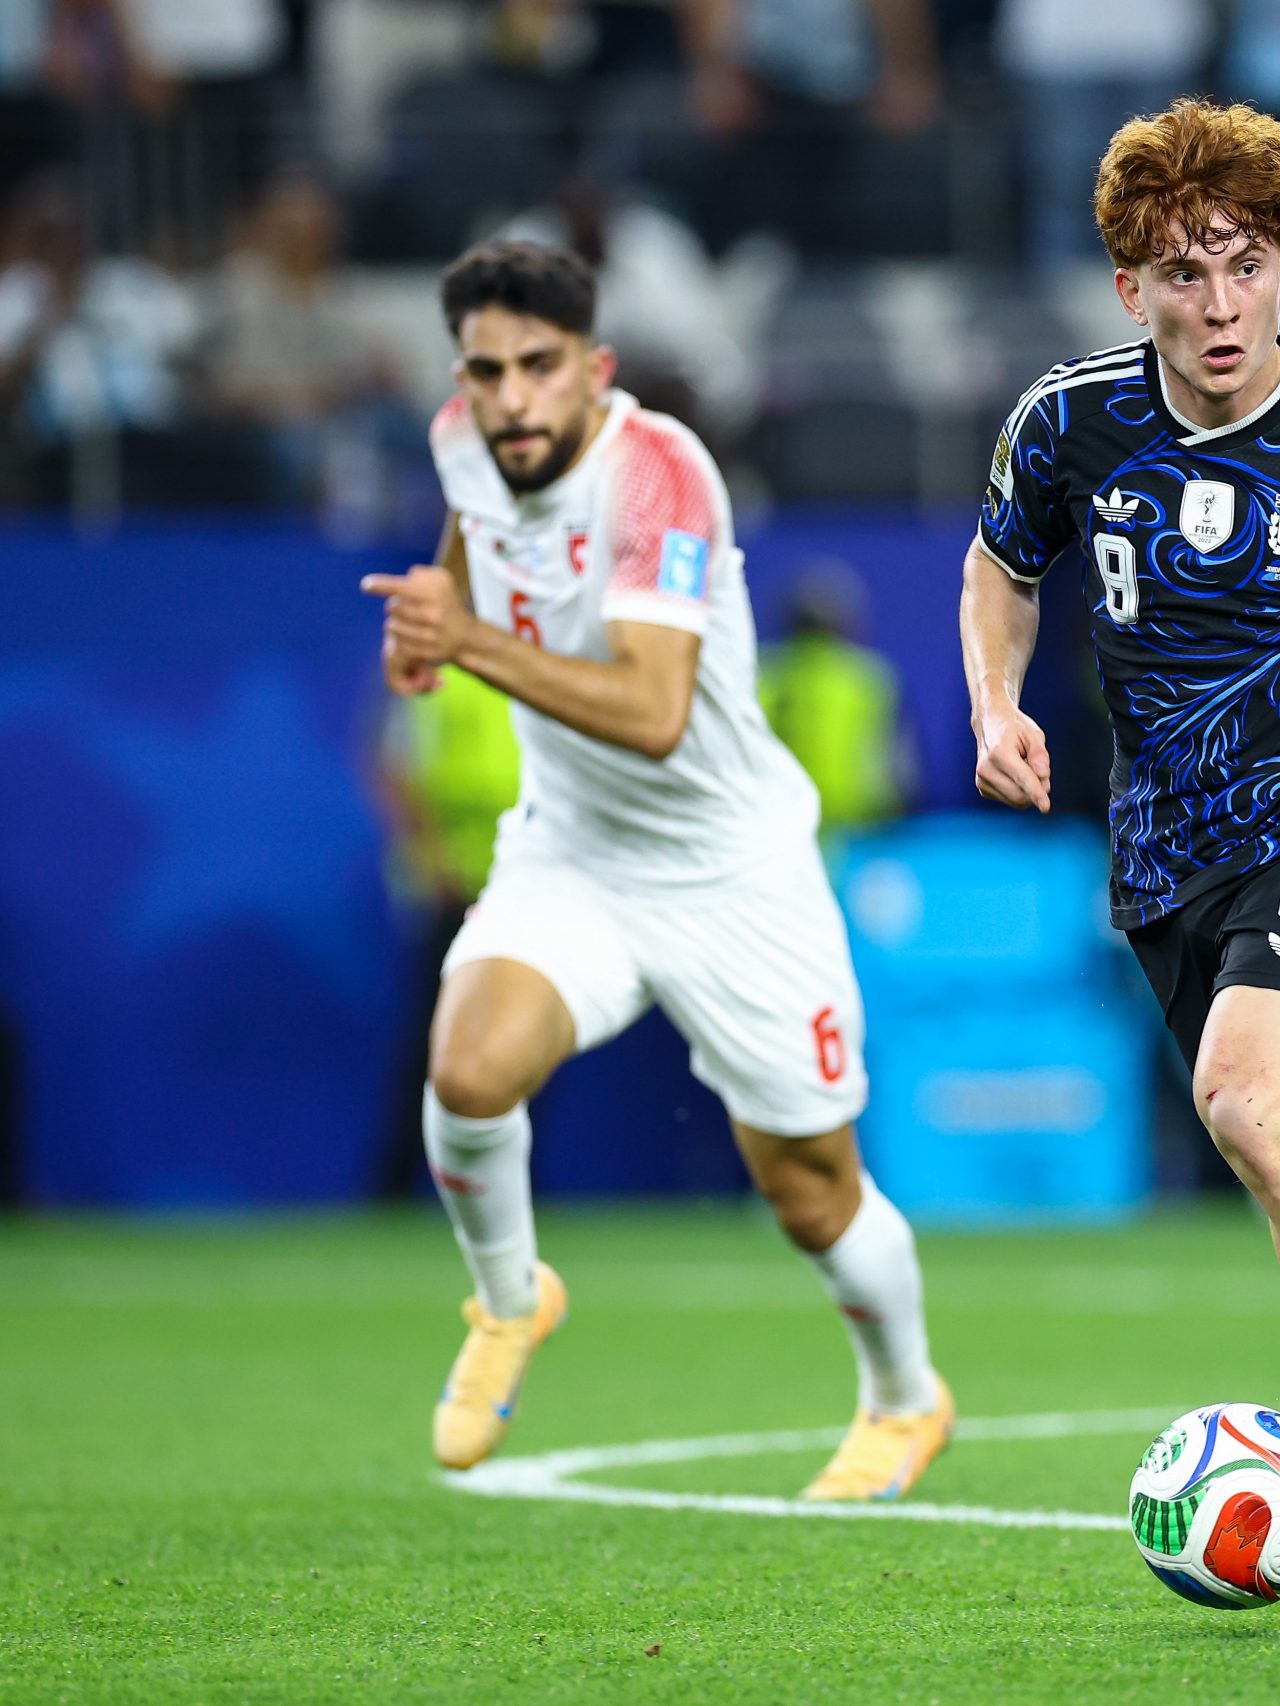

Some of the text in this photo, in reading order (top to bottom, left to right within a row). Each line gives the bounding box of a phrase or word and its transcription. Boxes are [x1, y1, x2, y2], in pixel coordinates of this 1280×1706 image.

[1195, 526, 1216, 534] FIFA
[1093, 532, 1139, 624] 8
[811, 1004, 845, 1083] 6
